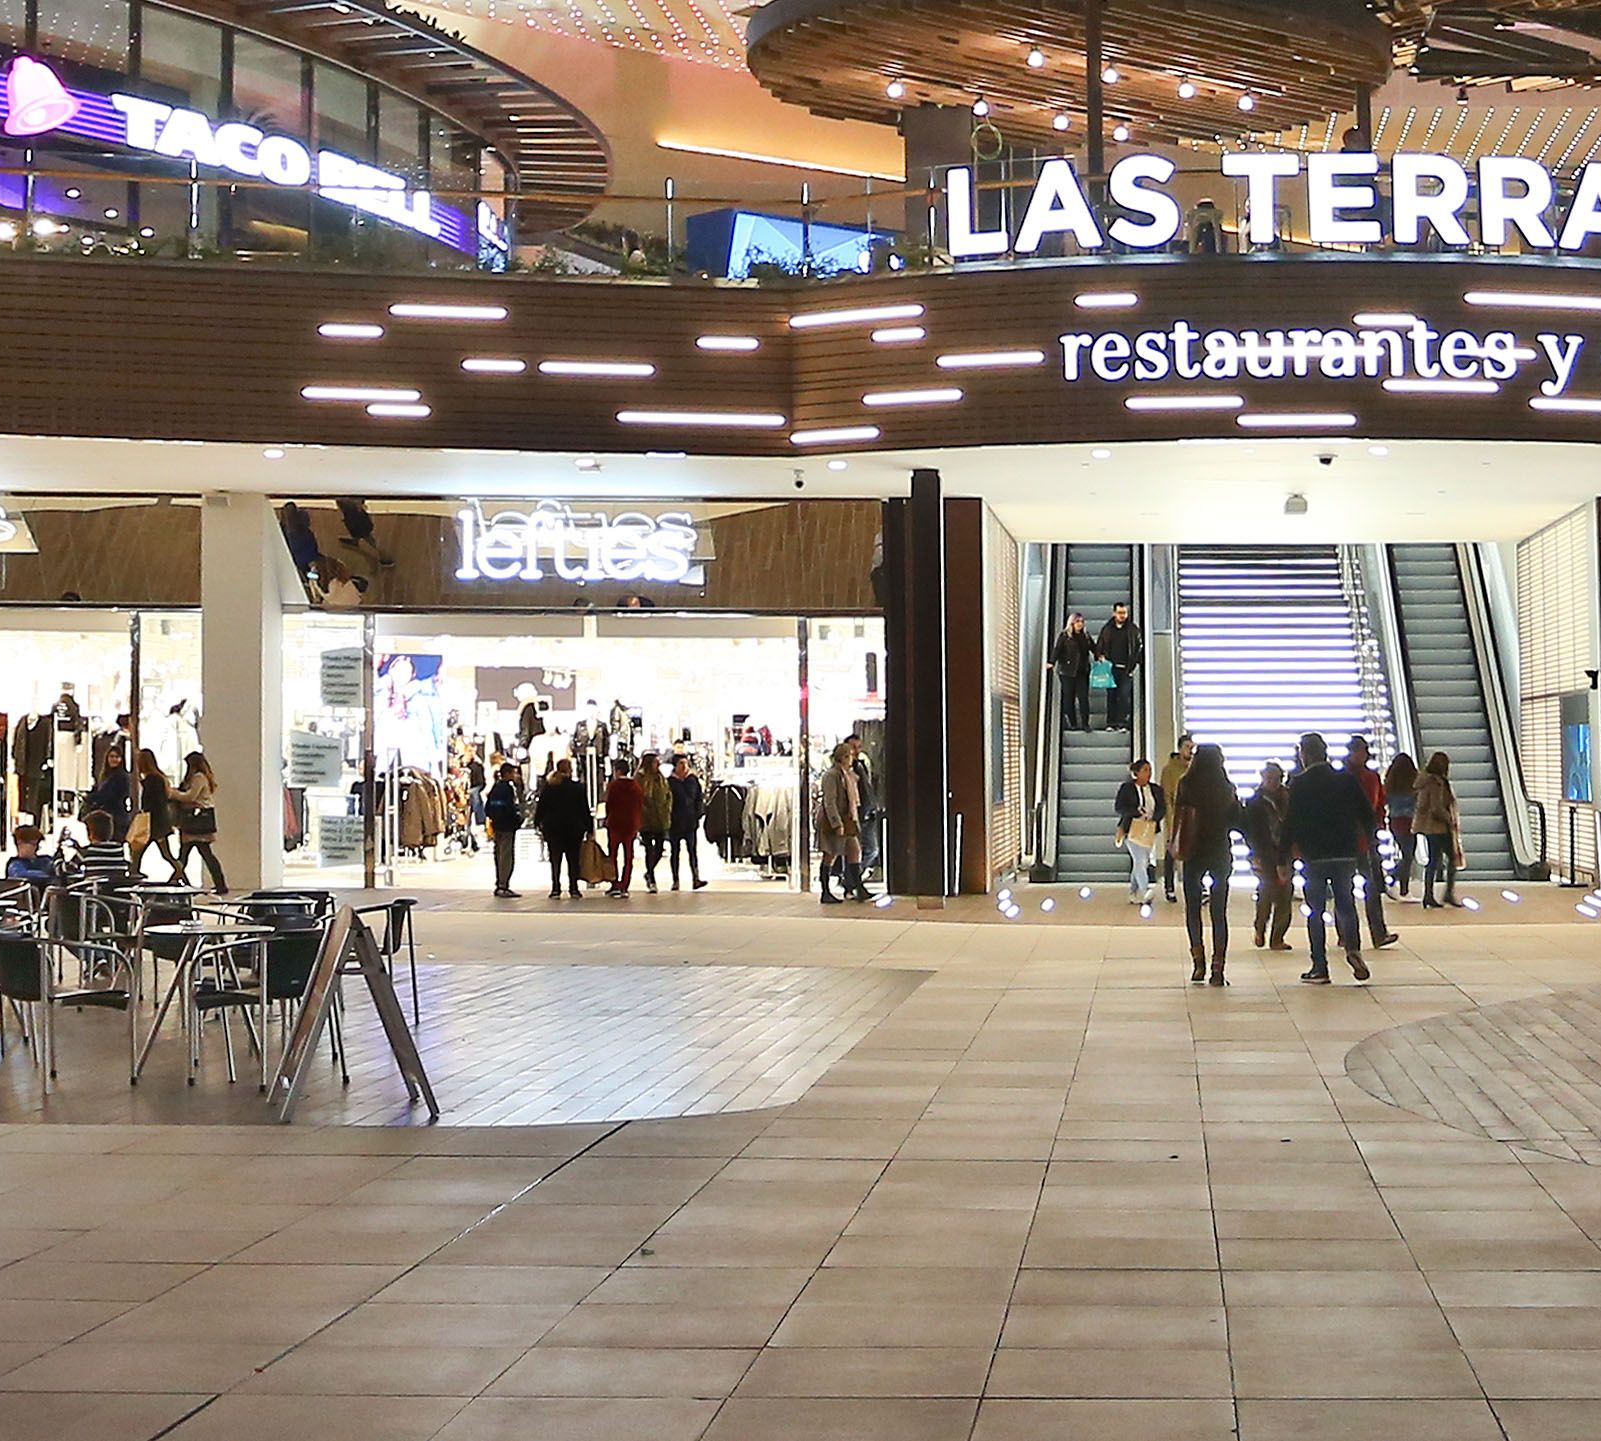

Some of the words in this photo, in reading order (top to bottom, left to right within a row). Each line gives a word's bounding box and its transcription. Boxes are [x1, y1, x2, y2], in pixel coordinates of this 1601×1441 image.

[110, 92, 312, 187] TACO
[317, 148, 442, 239] BELL
[945, 152, 1181, 259] LAS
[1058, 320, 1519, 383] restaurantes
[1536, 332, 1585, 397] y
[454, 506, 692, 582] lefties
